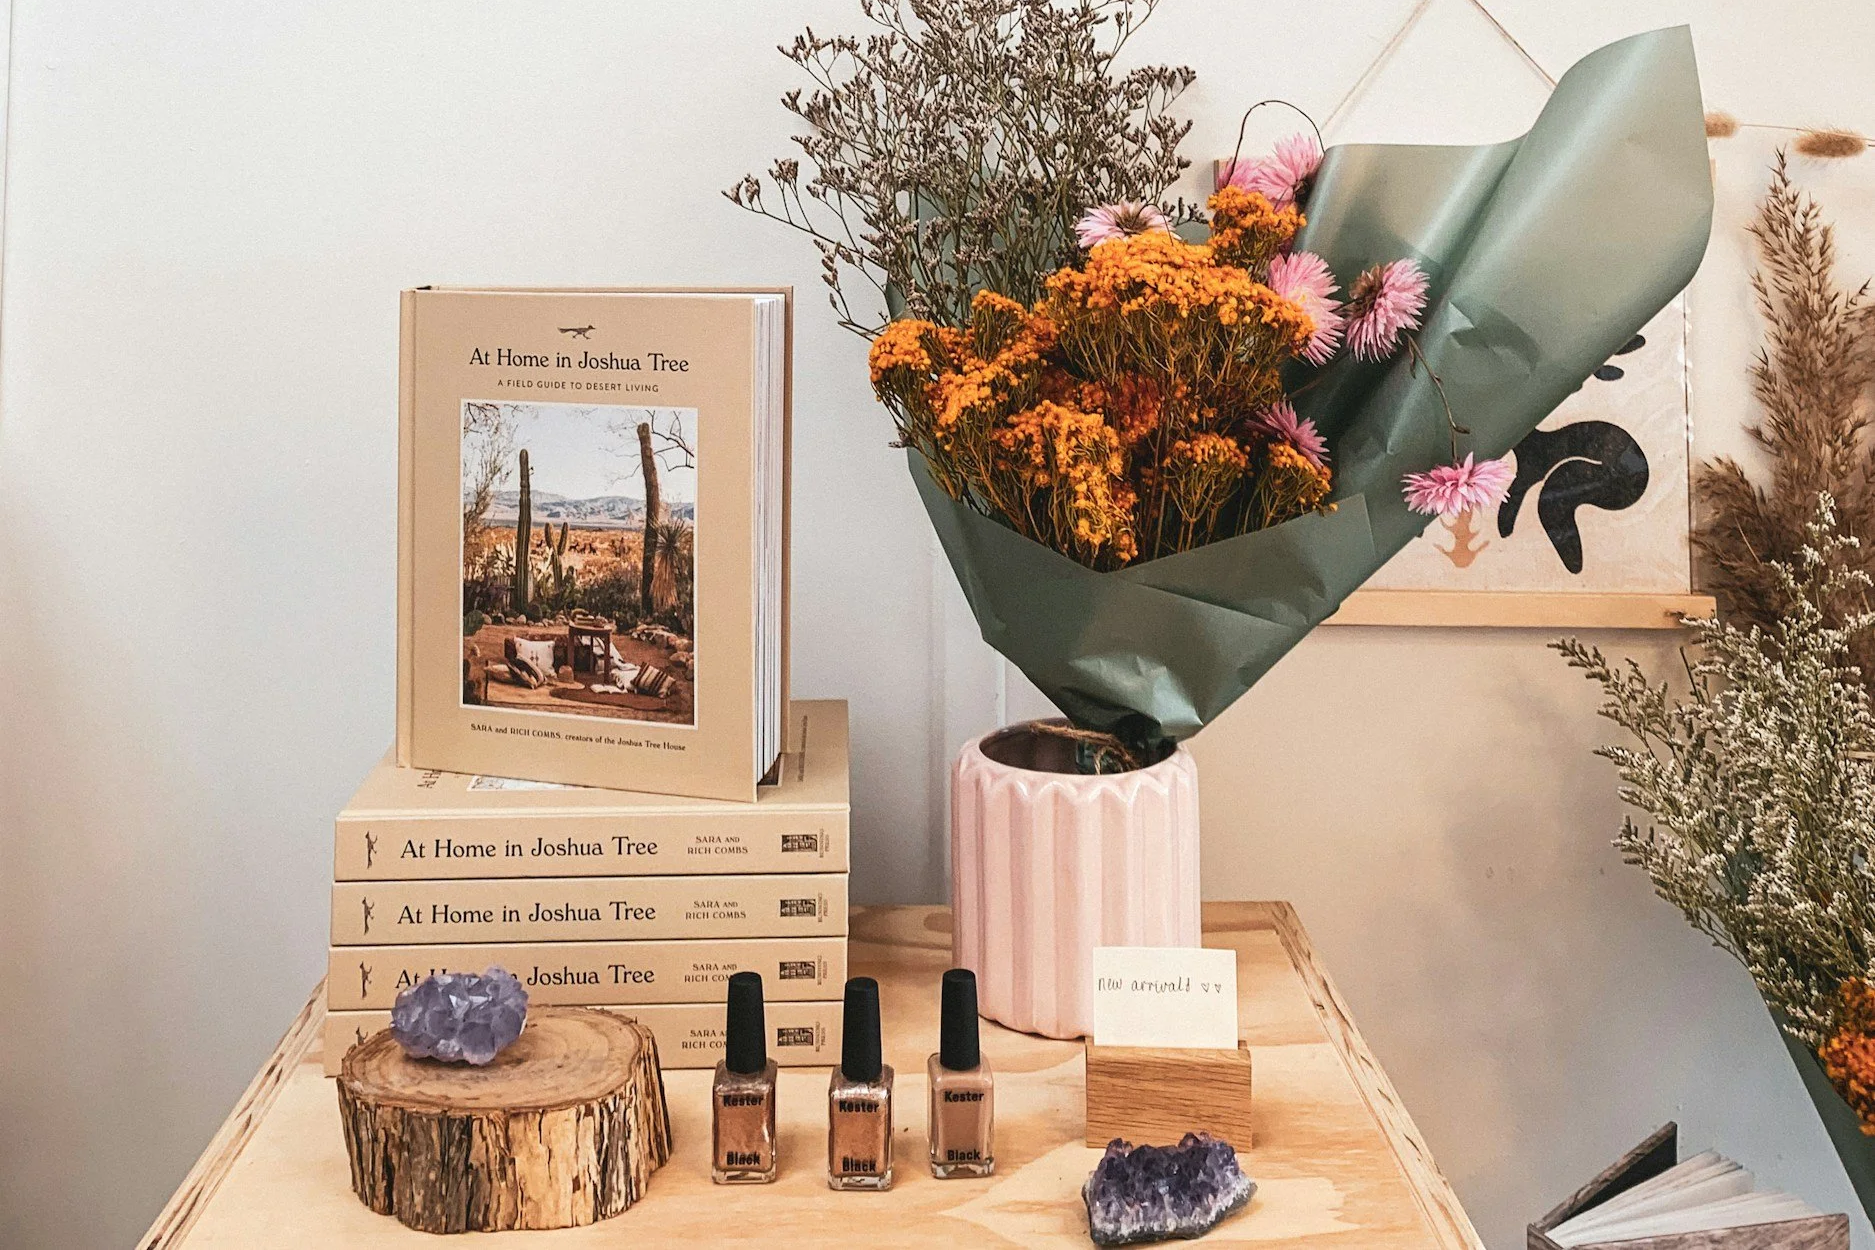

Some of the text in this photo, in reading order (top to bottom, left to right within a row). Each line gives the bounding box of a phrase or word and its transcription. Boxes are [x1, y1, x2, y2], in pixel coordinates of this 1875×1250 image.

[469, 347, 689, 372] At Home in Joshua Tree
[497, 379, 659, 393] A FIELD GUIDE TO DESERT LIVING
[470, 723, 493, 732] SARA
[495, 726, 508, 734] and
[510, 727, 530, 737] RICH
[564, 734, 593, 743] creators
[595, 736, 602, 744] of
[604, 737, 616, 746] the
[617, 738, 643, 748] Joshua
[645, 740, 661, 749] Tree
[663, 741, 686, 751] House
[695, 835, 722, 844] SARA
[400, 836, 659, 858] At Home in Joshua Tree
[687, 846, 749, 855] RICH COMBS
[693, 900, 720, 908] SARA
[397, 901, 656, 924] At Home in Joshua Tree
[685, 911, 747, 920] RICH COMBS
[692, 963, 737, 971] SARA AND
[395, 969, 420, 988] At
[526, 966, 600, 986] Joshua
[607, 964, 655, 985] Tree
[684, 974, 708, 983] RICH
[1098, 978, 1122, 991] new
[690, 1029, 716, 1038] SARA
[681, 1041, 706, 1049] RICH
[723, 1094, 764, 1107] Kester
[944, 1091, 984, 1102] Kester
[839, 1100, 880, 1113] Kester
[726, 1151, 761, 1166] Black
[947, 1148, 980, 1161] Black
[842, 1156, 877, 1173] Black
